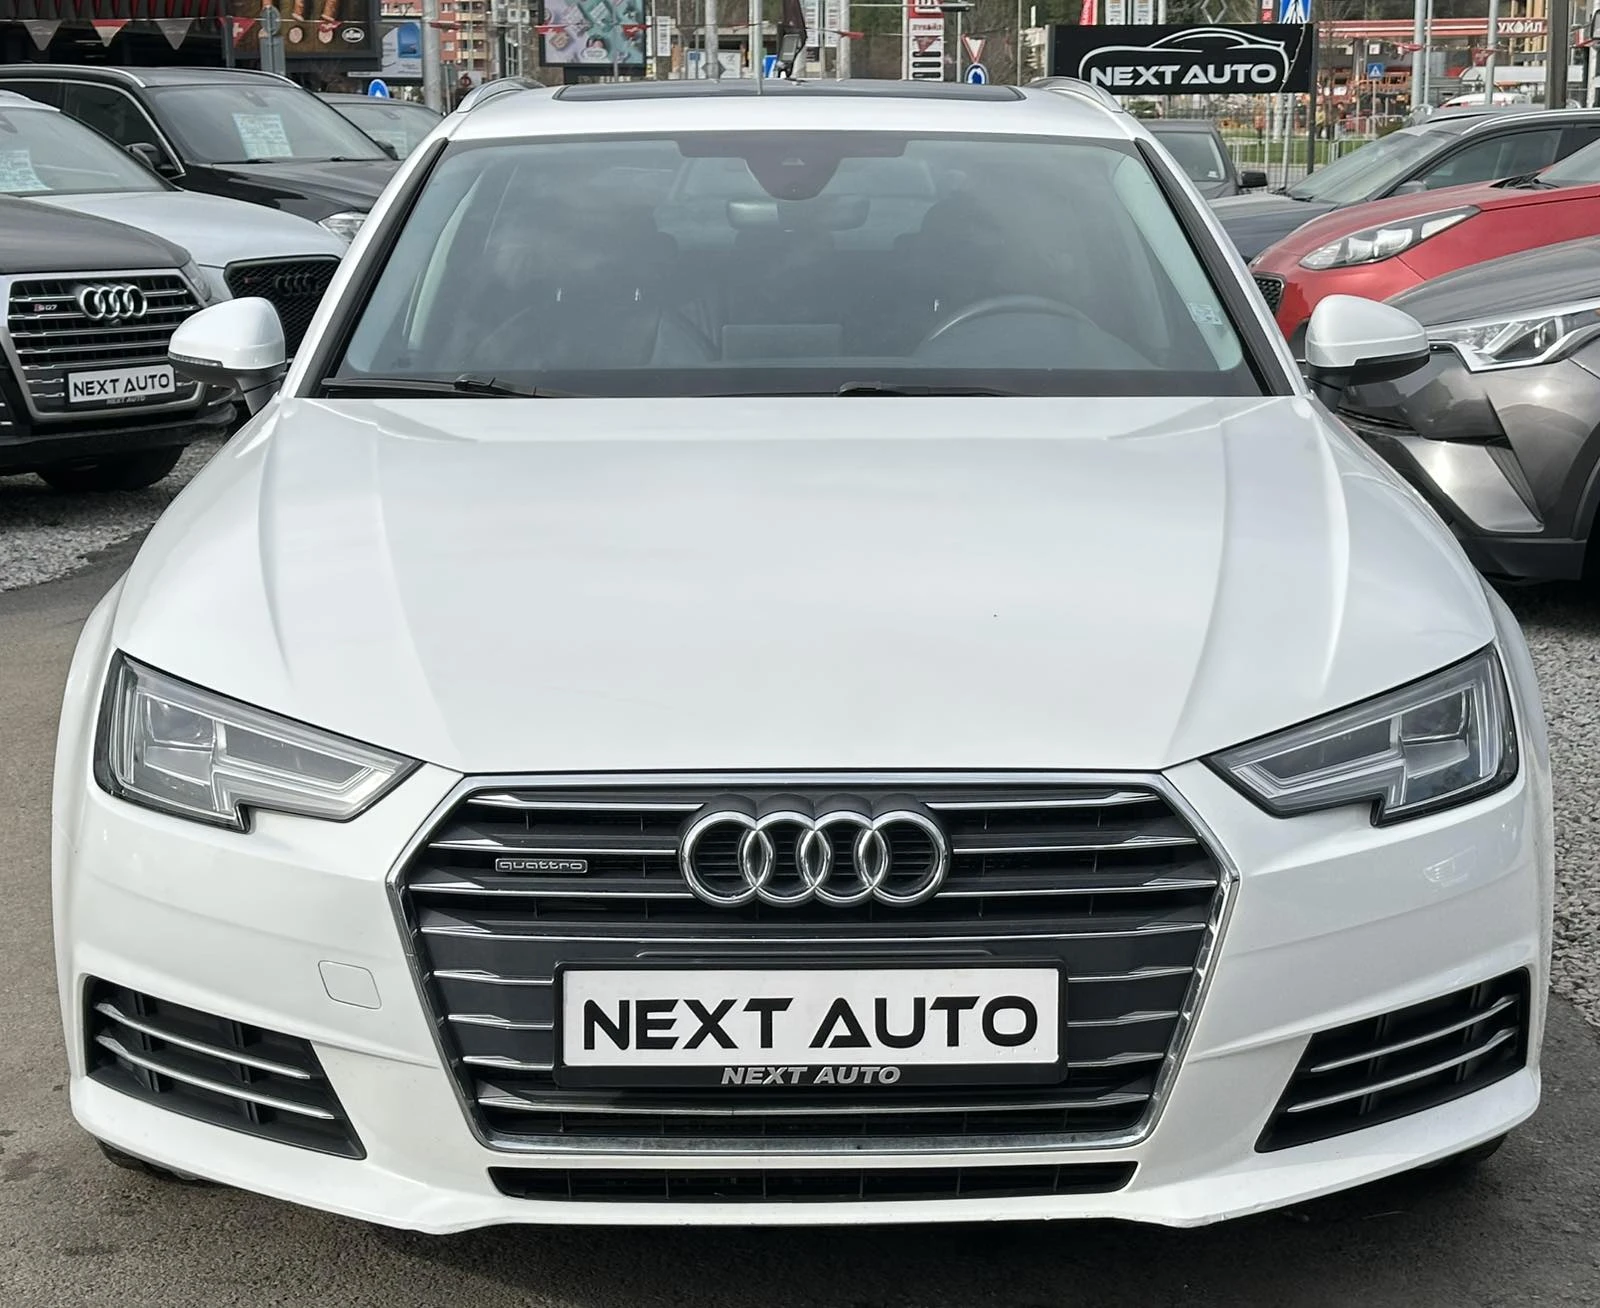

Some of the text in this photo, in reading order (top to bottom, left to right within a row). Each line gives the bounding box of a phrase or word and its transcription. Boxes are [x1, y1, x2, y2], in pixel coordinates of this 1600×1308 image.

[1497, 20, 1544, 34] УКОЙЛ
[1090, 64, 1277, 87] NEXT AUTO
[73, 373, 170, 397] NEXT AUTO
[500, 861, 582, 871] quattro
[583, 995, 1038, 1051] NEXT AUTO
[721, 1066, 901, 1085] NEXT AUTO
